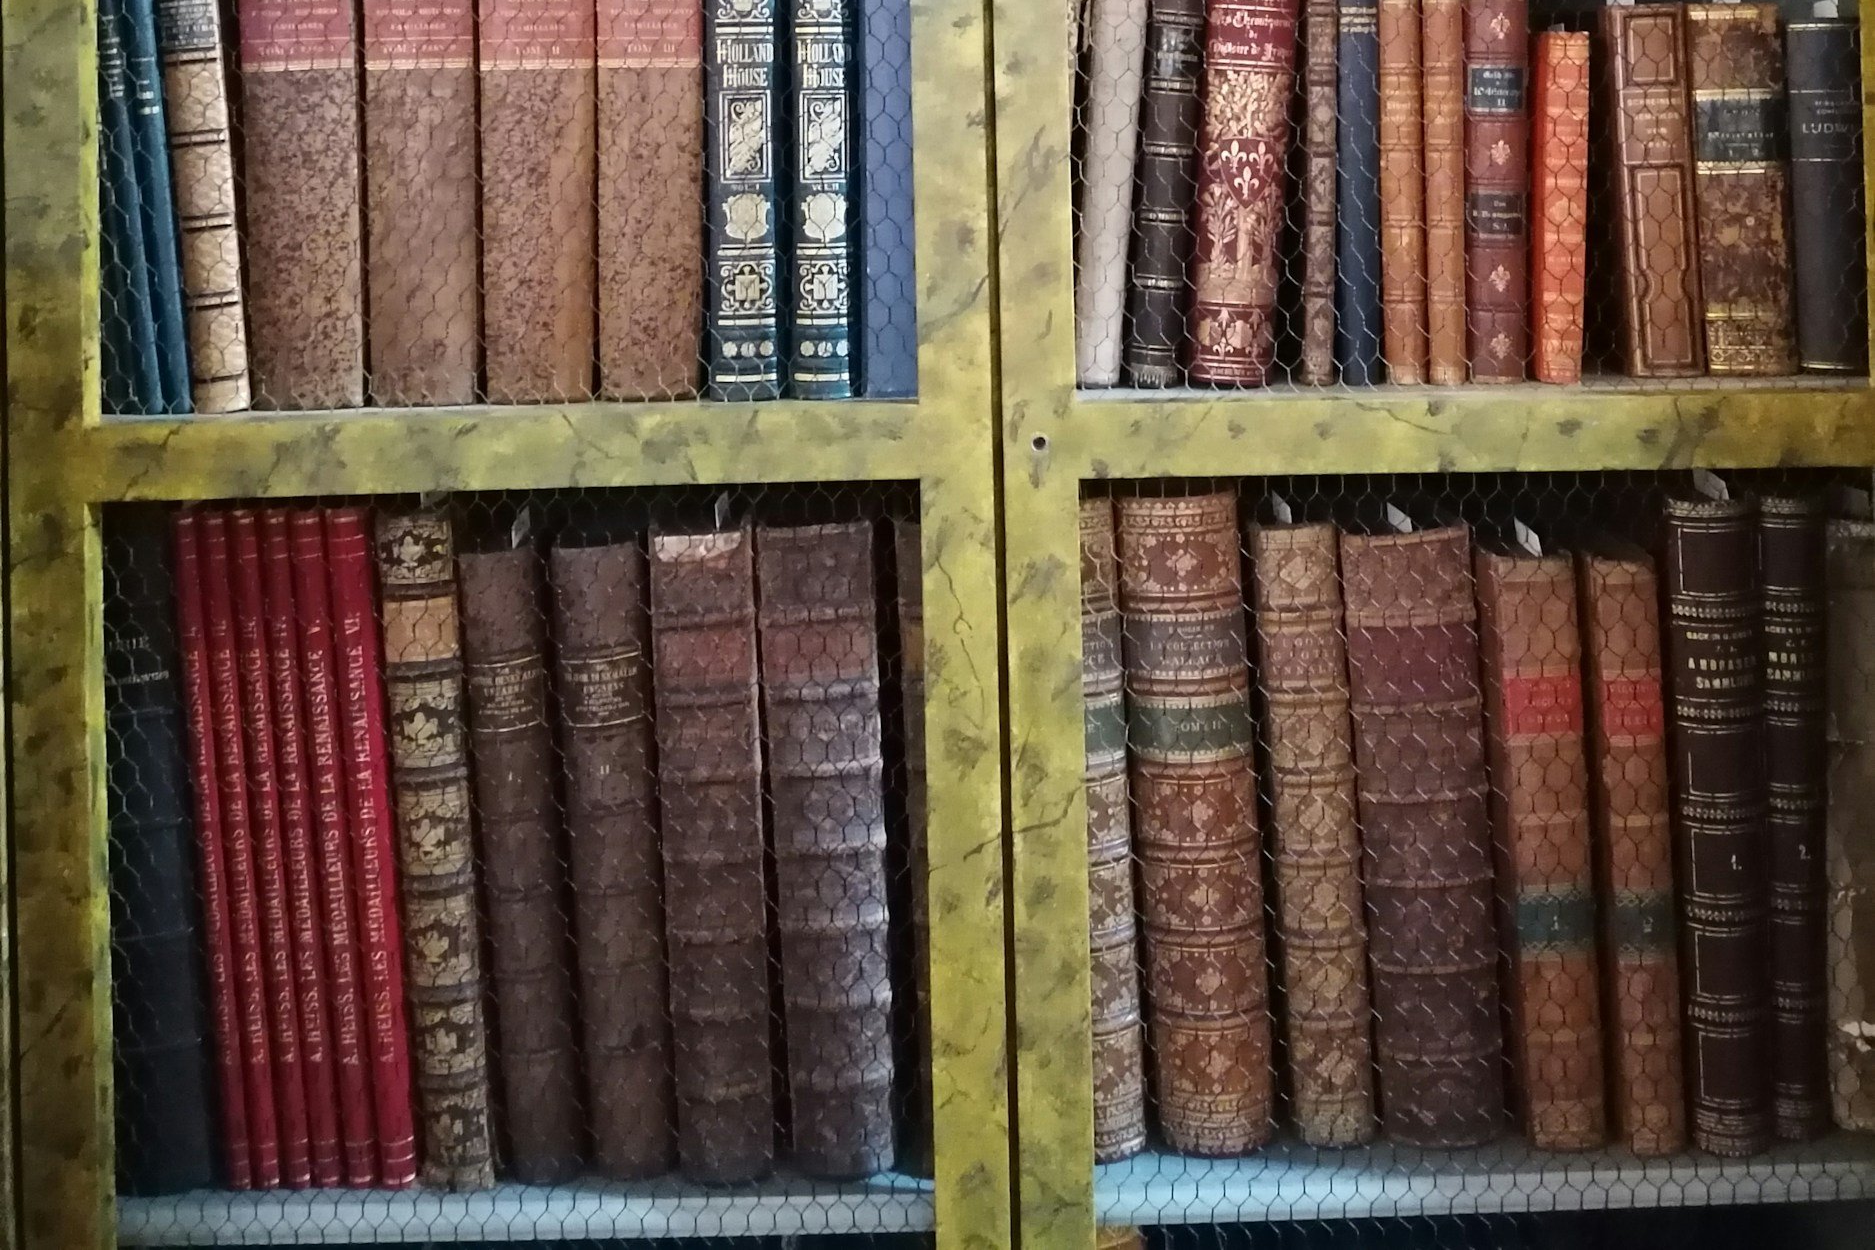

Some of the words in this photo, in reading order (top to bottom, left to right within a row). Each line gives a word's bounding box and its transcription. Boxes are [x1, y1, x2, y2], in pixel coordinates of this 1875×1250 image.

[716, 39, 774, 65] HOLLAND
[796, 39, 852, 65] HOLLAND
[722, 64, 769, 89] HOUSE
[802, 63, 846, 89] HOUSE
[307, 650, 333, 765] RENAISSANCE
[319, 773, 336, 794] LA
[287, 800, 302, 820] DE
[322, 800, 338, 821] DE
[358, 797, 376, 818] DE
[1730, 853, 1743, 872] 1.
[1798, 843, 1812, 861] 2.
[334, 952, 352, 982] LES
